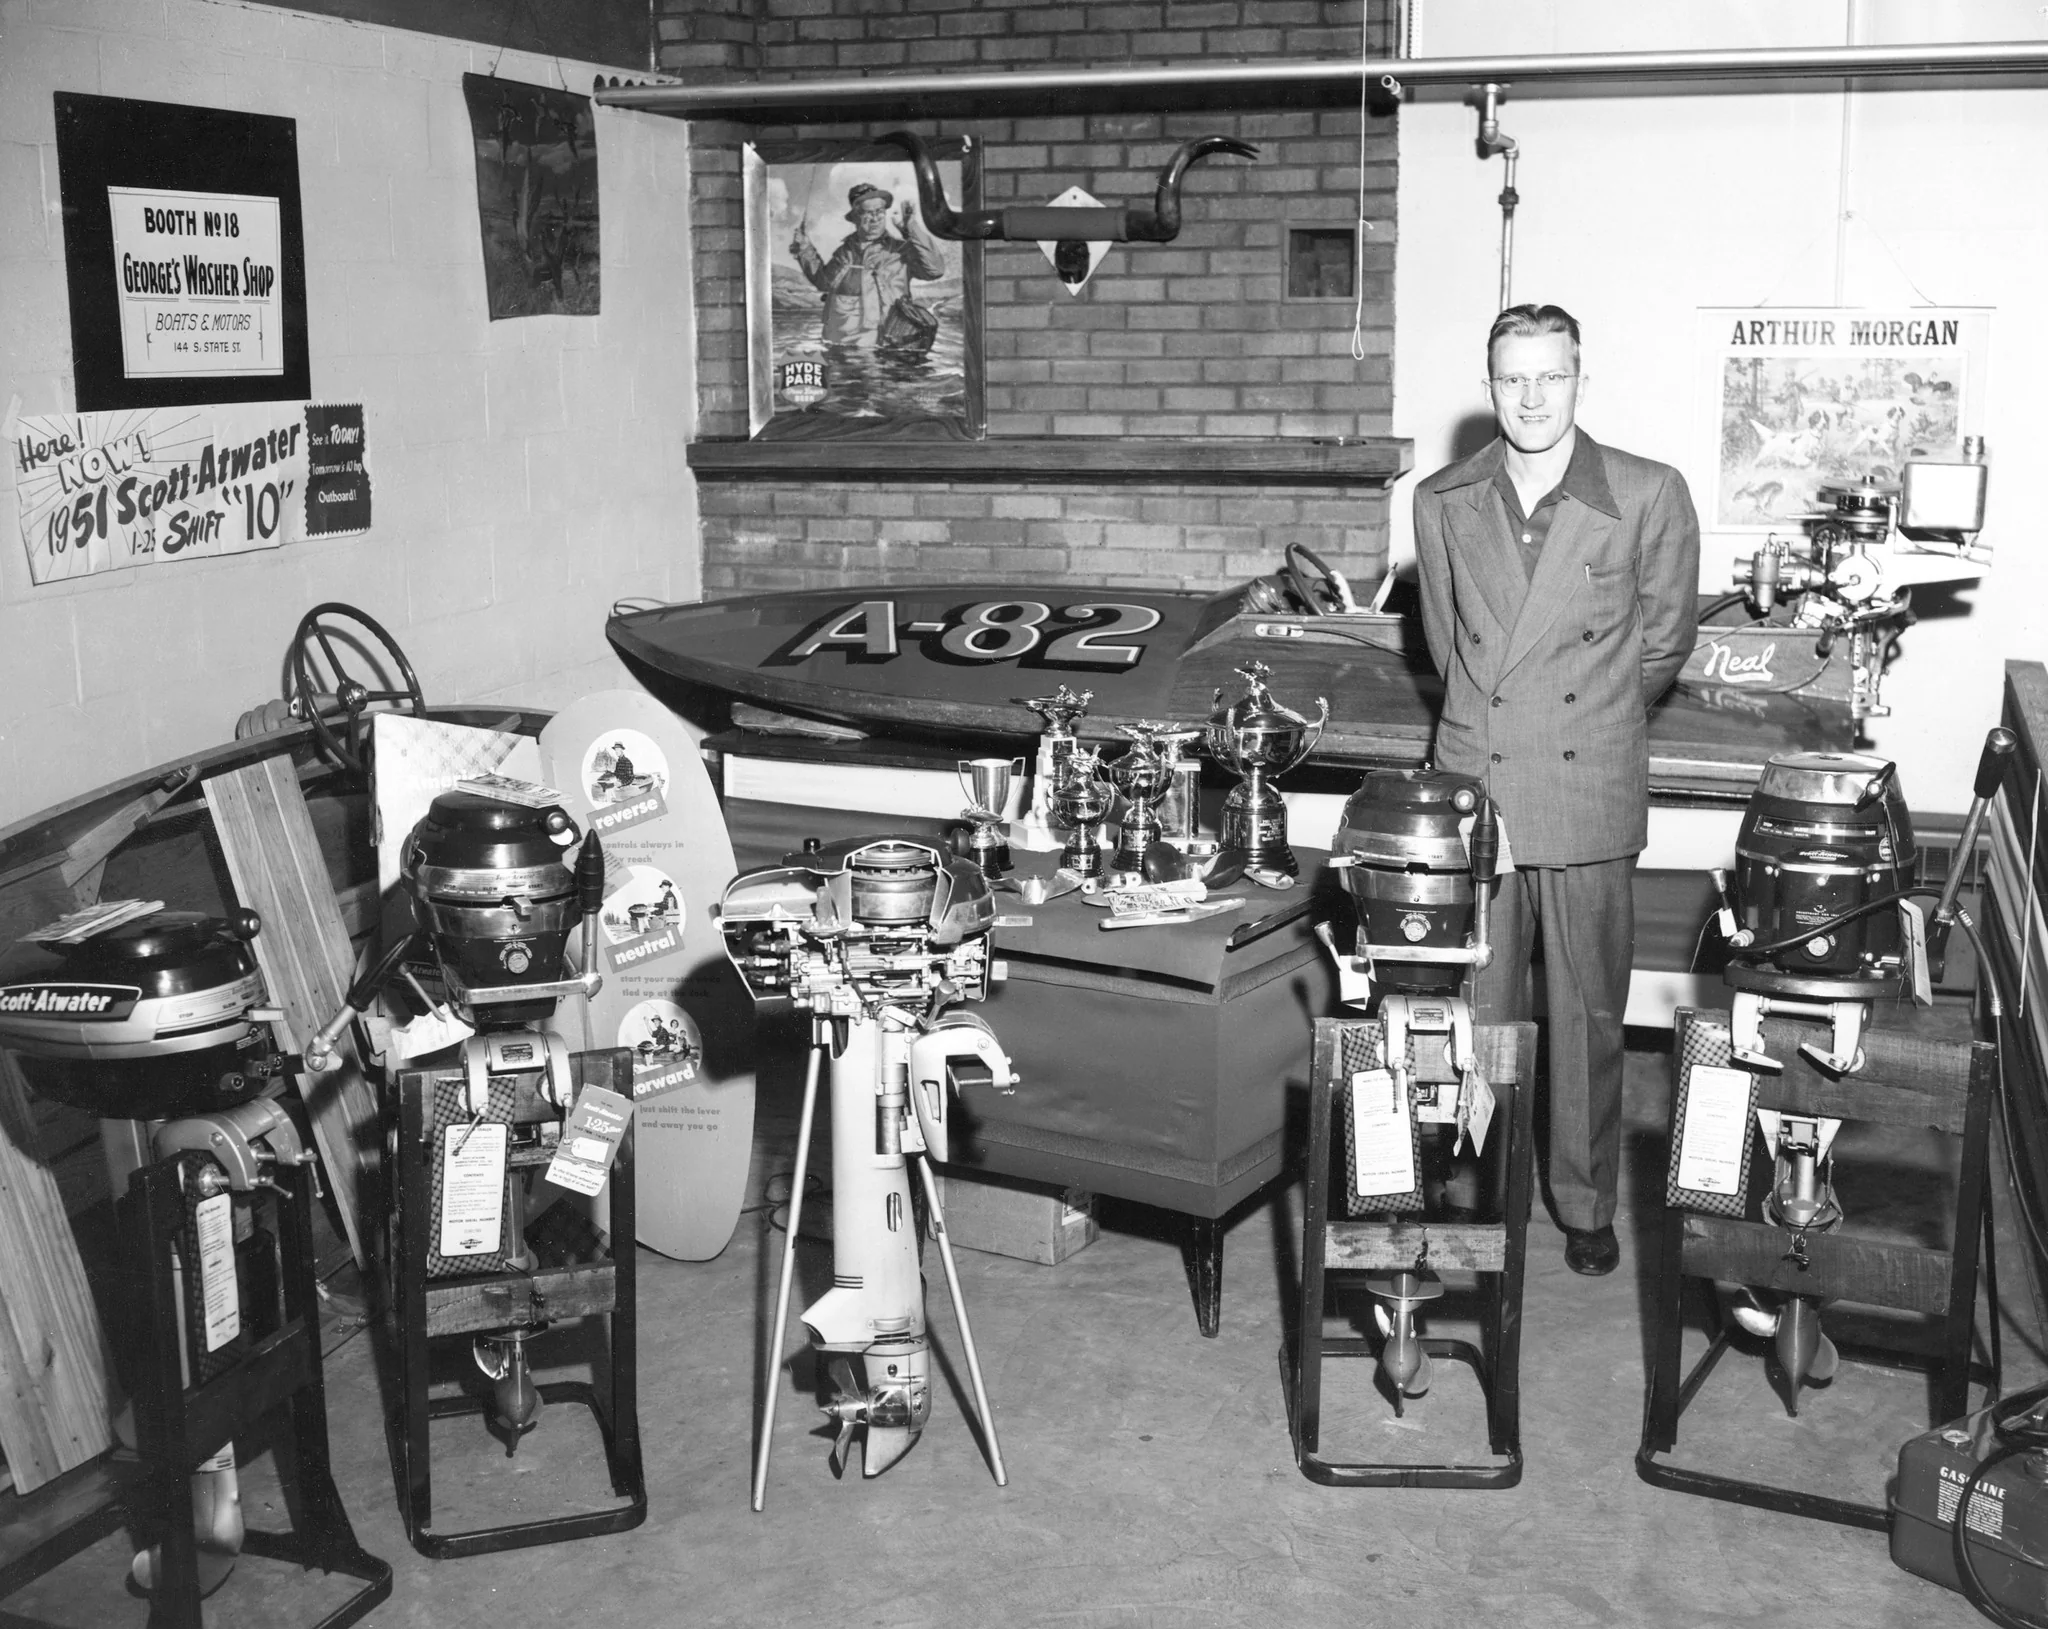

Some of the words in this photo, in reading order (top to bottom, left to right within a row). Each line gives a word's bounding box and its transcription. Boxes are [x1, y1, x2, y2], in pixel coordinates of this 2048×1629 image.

[144, 207, 197, 236] BOOTH
[123, 252, 181, 295] GEORGE'S
[183, 254, 240, 297] WASHER
[243, 256, 274, 298] SHOP
[155, 312, 198, 331] BOATS
[201, 313, 209, 331] &
[212, 313, 251, 331] MOTORS
[1731, 320, 1836, 345] ARTHUR
[1849, 320, 1959, 346] MORGAN
[174, 342, 188, 352] 144
[204, 342, 229, 352] STATE
[785, 362, 822, 376] HYDE
[785, 374, 822, 387] PARK
[18, 417, 85, 473] Here!
[312, 433, 323, 446] See
[324, 433, 329, 445] it
[330, 424, 359, 444] TODAY!
[58, 429, 151, 495] NOW!
[311, 461, 345, 475] Tomorrow's
[346, 460, 353, 472] 10
[353, 460, 362, 475] hp
[49, 484, 108, 556] 1951
[116, 423, 300, 525] Scott-Atwater
[318, 489, 357, 503] Outboard!
[162, 510, 225, 554] SHIFT
[772, 600, 1161, 668] A-82
[1704, 641, 1776, 683] Neal
[595, 798, 659, 830] reverse
[603, 841, 637, 849] ontrols
[640, 841, 672, 850] always
[627, 855, 652, 863] reach
[614, 930, 676, 965] neutral
[643, 990, 654, 998] up
[640, 1105, 655, 1114] just
[681, 1106, 695, 1114] the
[698, 1107, 720, 1115] lever
[660, 1122, 684, 1131] away
[687, 1123, 704, 1131] you
[1939, 1466, 2007, 1500] GASLINE
